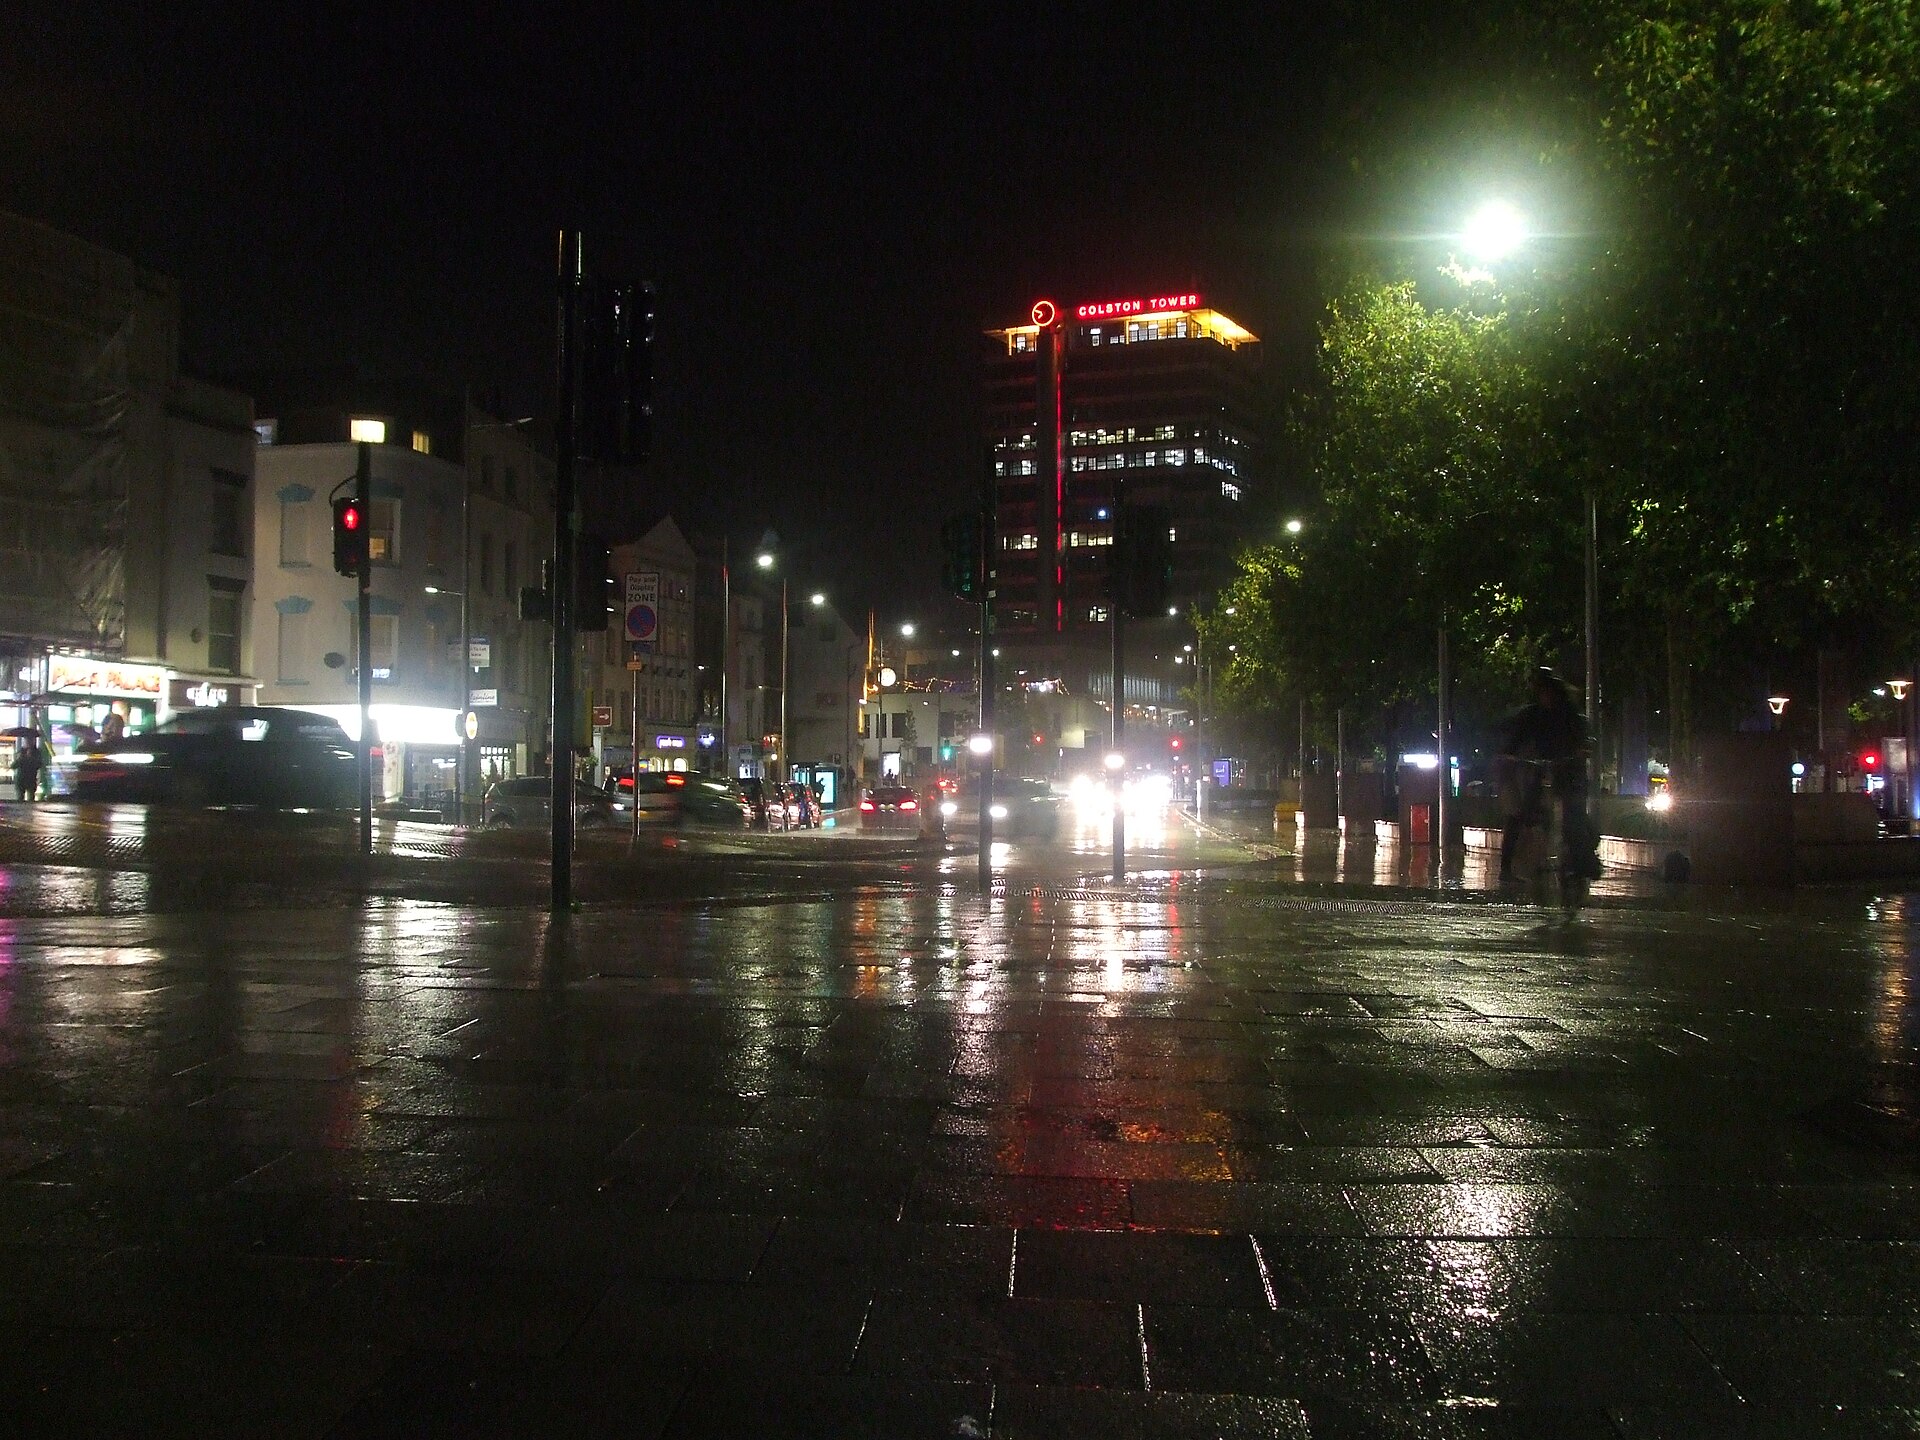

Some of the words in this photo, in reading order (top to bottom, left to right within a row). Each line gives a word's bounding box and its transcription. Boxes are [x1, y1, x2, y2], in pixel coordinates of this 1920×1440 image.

[1078, 300, 1141, 317] COLSTON
[1150, 294, 1197, 309] TOWER
[627, 593, 656, 602] ZONE
